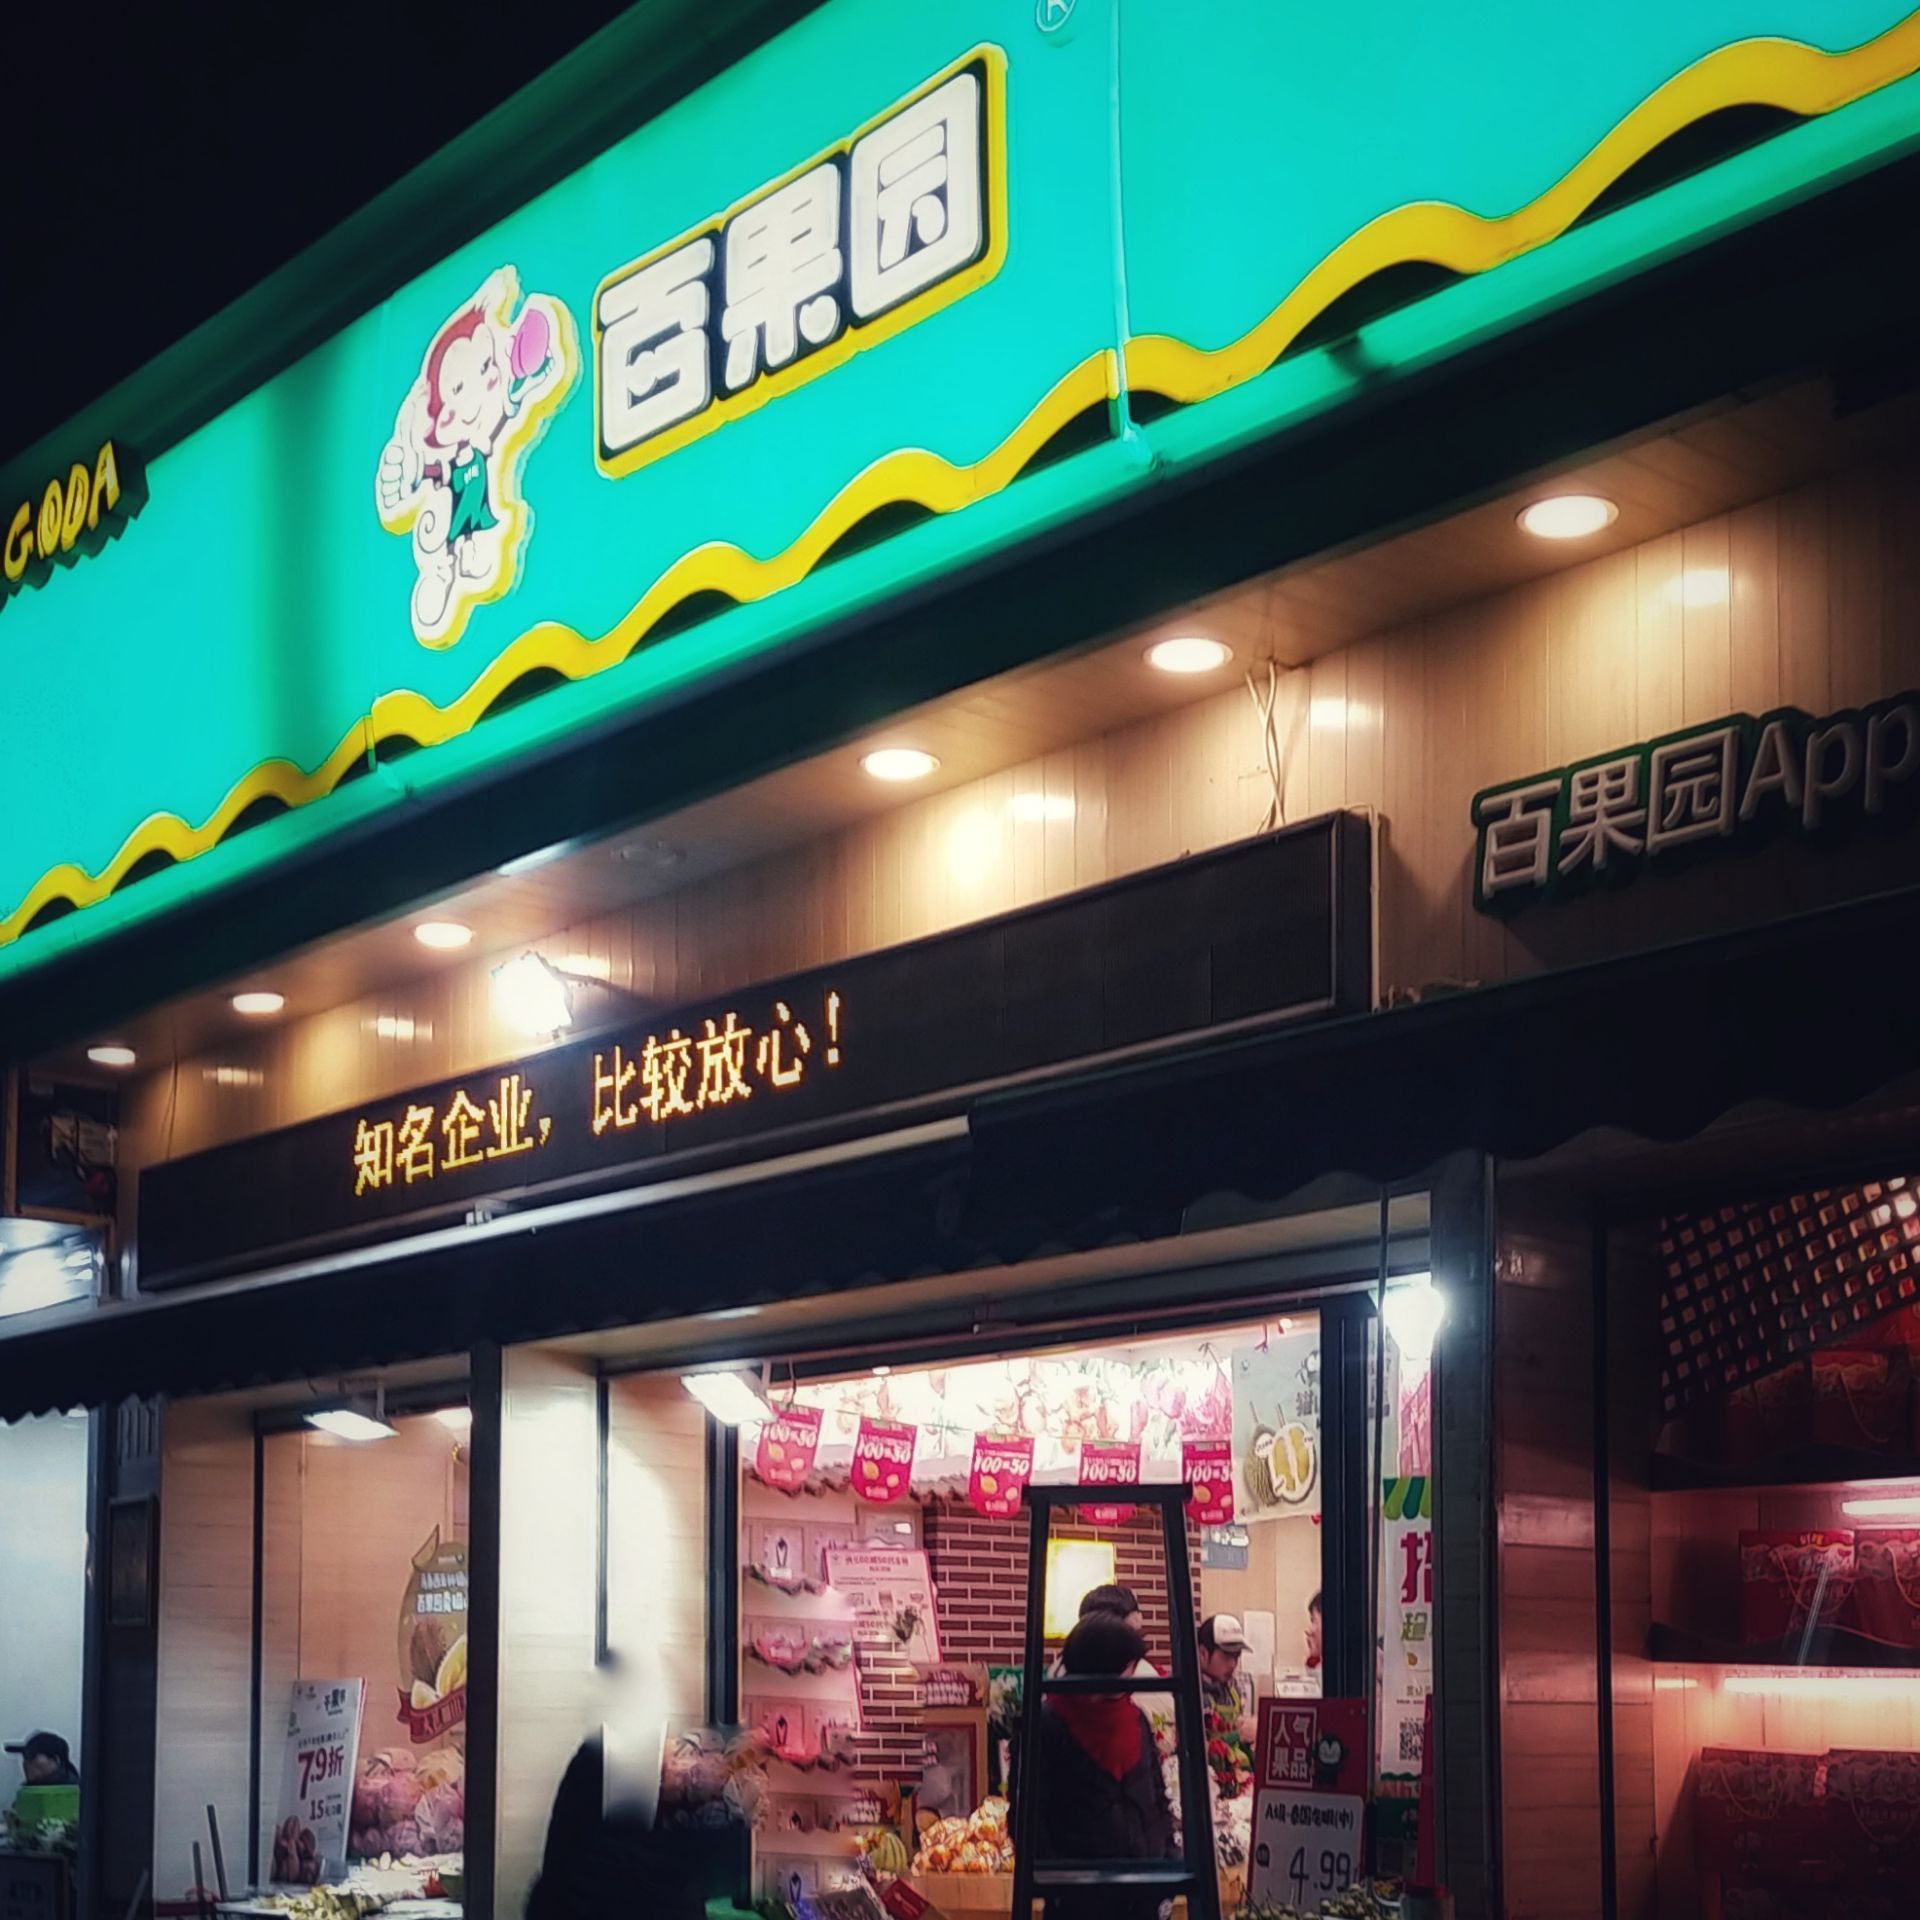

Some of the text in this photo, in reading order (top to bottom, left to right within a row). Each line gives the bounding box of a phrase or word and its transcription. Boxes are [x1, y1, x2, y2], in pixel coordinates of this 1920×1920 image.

[598, 70, 982, 452] 百果园
[354, 991, 840, 1196] 知名企业， 比较放心！
[1273, 1713, 1310, 1746] 人气
[298, 1745, 344, 1800] 7.9折
[1272, 1746, 1308, 1780] 果品
[1289, 1846, 1350, 1904] 4.99
